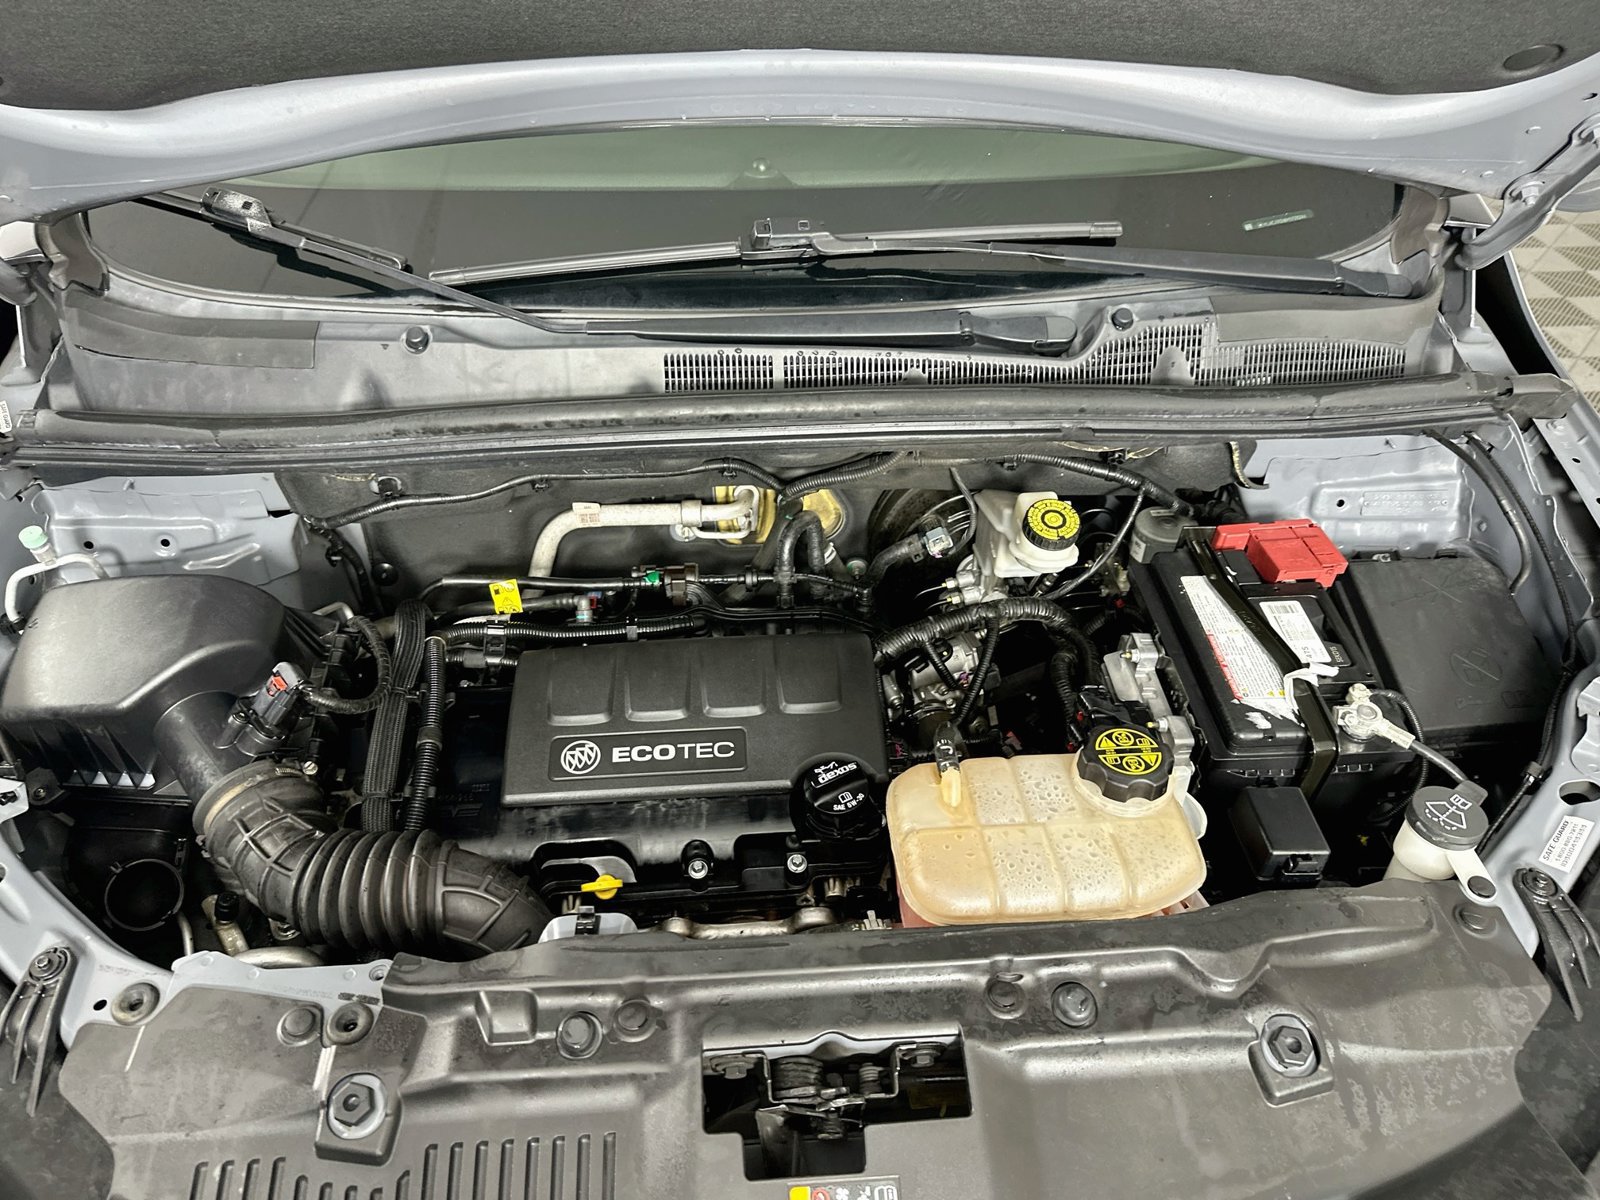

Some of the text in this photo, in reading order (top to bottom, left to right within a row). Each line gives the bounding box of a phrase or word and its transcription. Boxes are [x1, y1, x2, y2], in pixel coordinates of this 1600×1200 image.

[612, 741, 735, 763] ECOTEC
[818, 761, 858, 784] dexos
[833, 792, 865, 811] SAE 5W-30
[1542, 820, 1570, 861] SAFE GUARD
